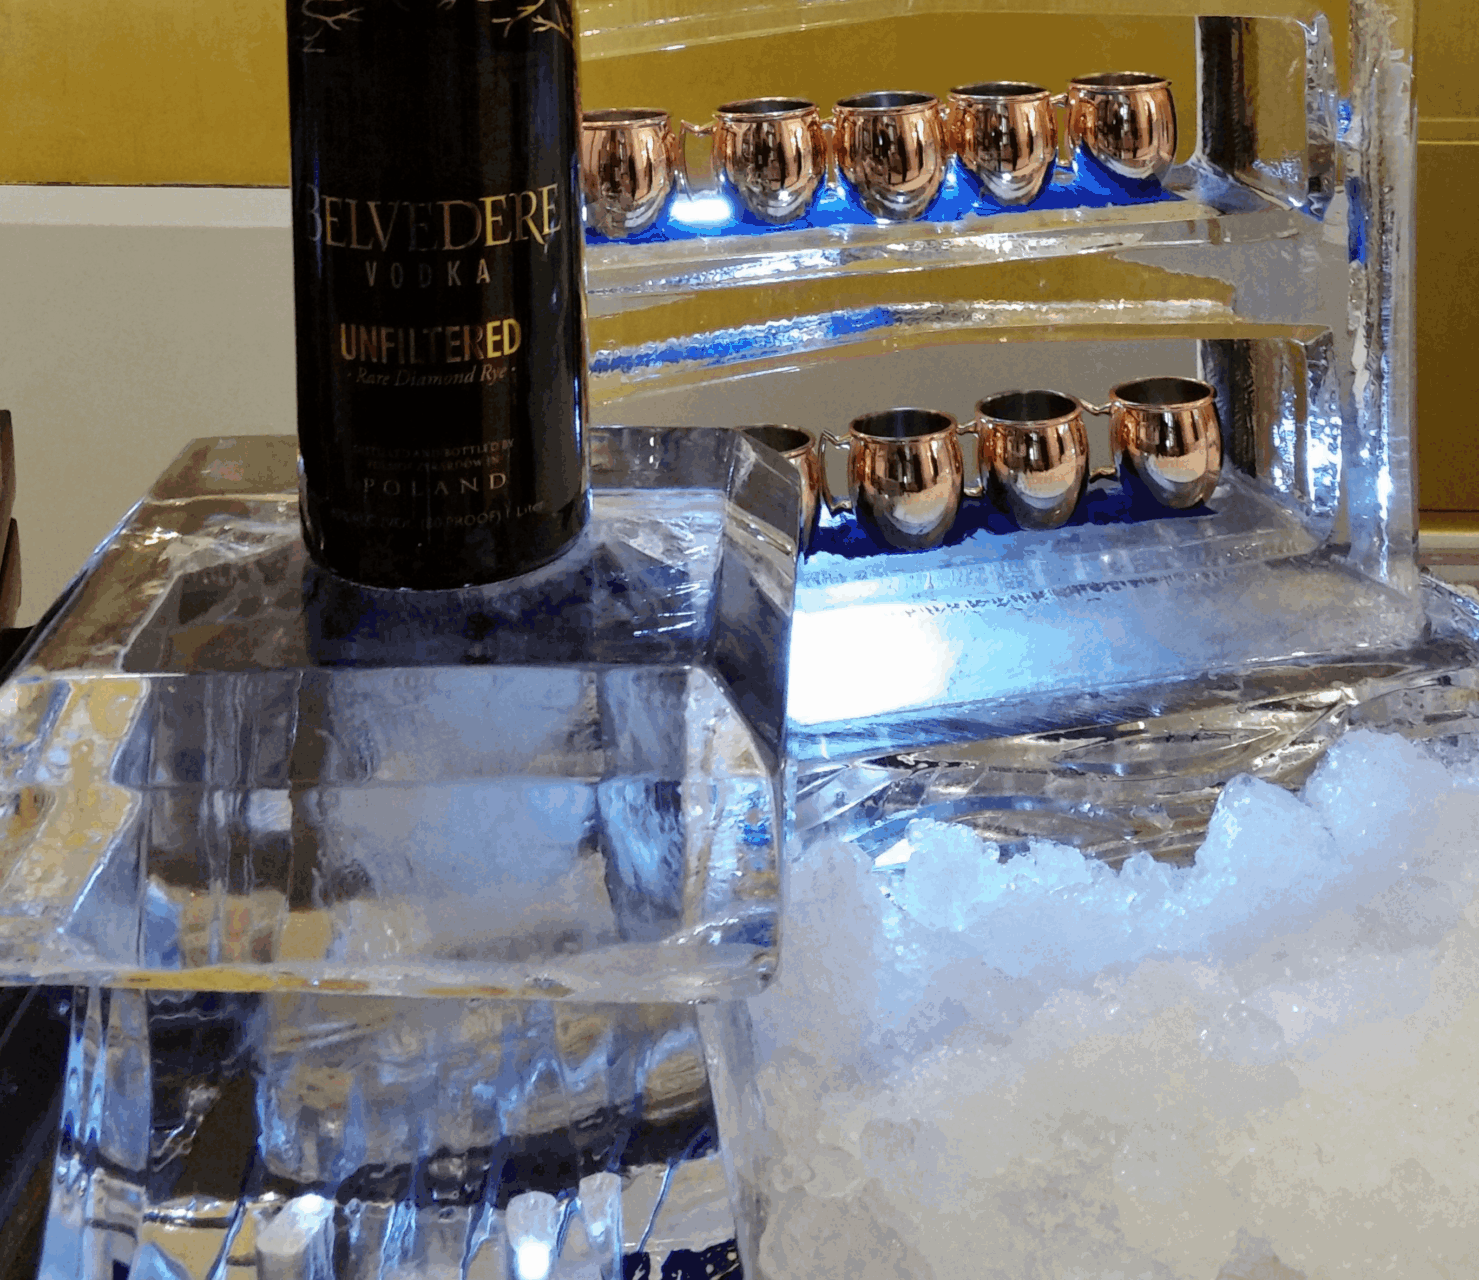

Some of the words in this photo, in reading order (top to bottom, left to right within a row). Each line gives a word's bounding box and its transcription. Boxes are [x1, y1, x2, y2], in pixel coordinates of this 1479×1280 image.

[306, 183, 561, 252] BELVEDERE
[366, 258, 491, 288] VODKA
[340, 318, 522, 365] UNFILTERED
[356, 366, 390, 386] Rare
[393, 364, 478, 387] Diamond
[480, 363, 507, 386] Rye
[363, 472, 507, 497] POLAND
